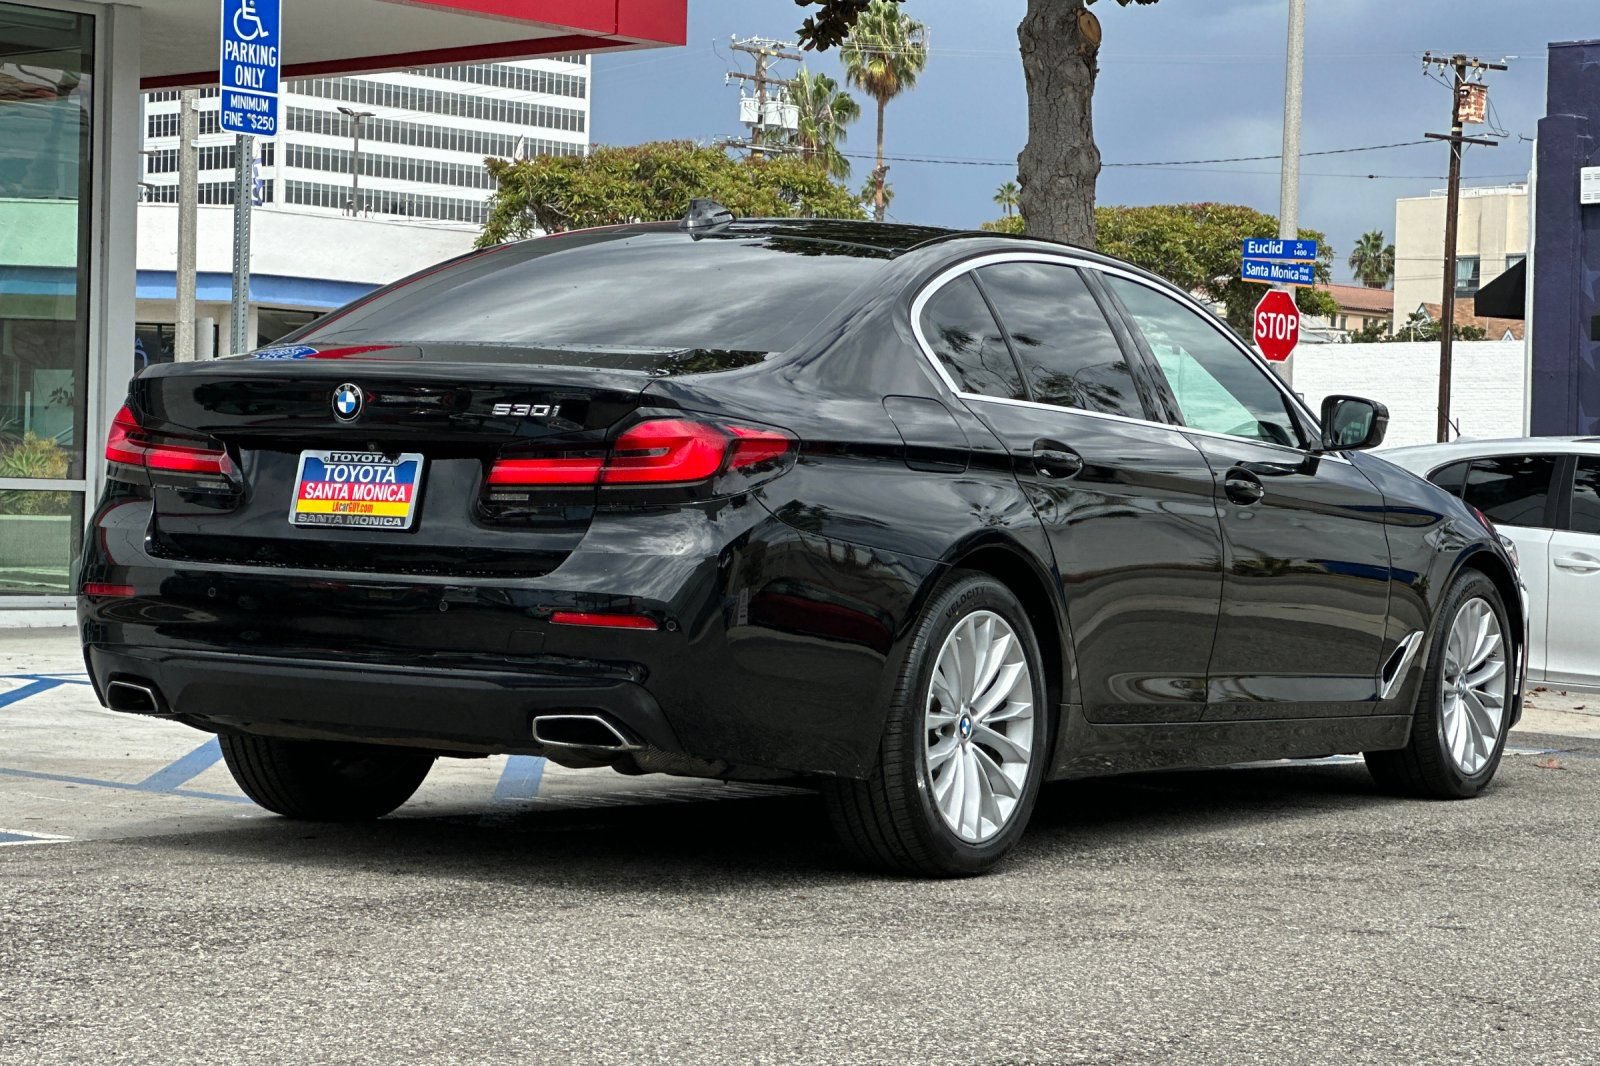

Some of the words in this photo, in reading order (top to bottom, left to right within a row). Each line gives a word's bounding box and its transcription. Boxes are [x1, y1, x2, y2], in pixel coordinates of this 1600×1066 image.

[225, 40, 277, 68] PARKING
[235, 65, 265, 89] ONLY
[230, 94, 269, 113] MINIMUM
[224, 111, 244, 127] FINE
[250, 114, 275, 131] $250
[1248, 241, 1284, 255] Euclid
[1246, 262, 1269, 277] Santa
[1271, 265, 1299, 280] Monica
[1257, 311, 1297, 341] STOP
[492, 403, 561, 417] 530i
[332, 453, 392, 464] TOYOTA
[323, 464, 397, 484] TOYOTA
[305, 482, 349, 501] SANTA
[352, 484, 406, 502] MONICA
[298, 513, 342, 525] SANTA
[346, 515, 401, 527] MONICA
[945, 586, 985, 618] VELOCITY
